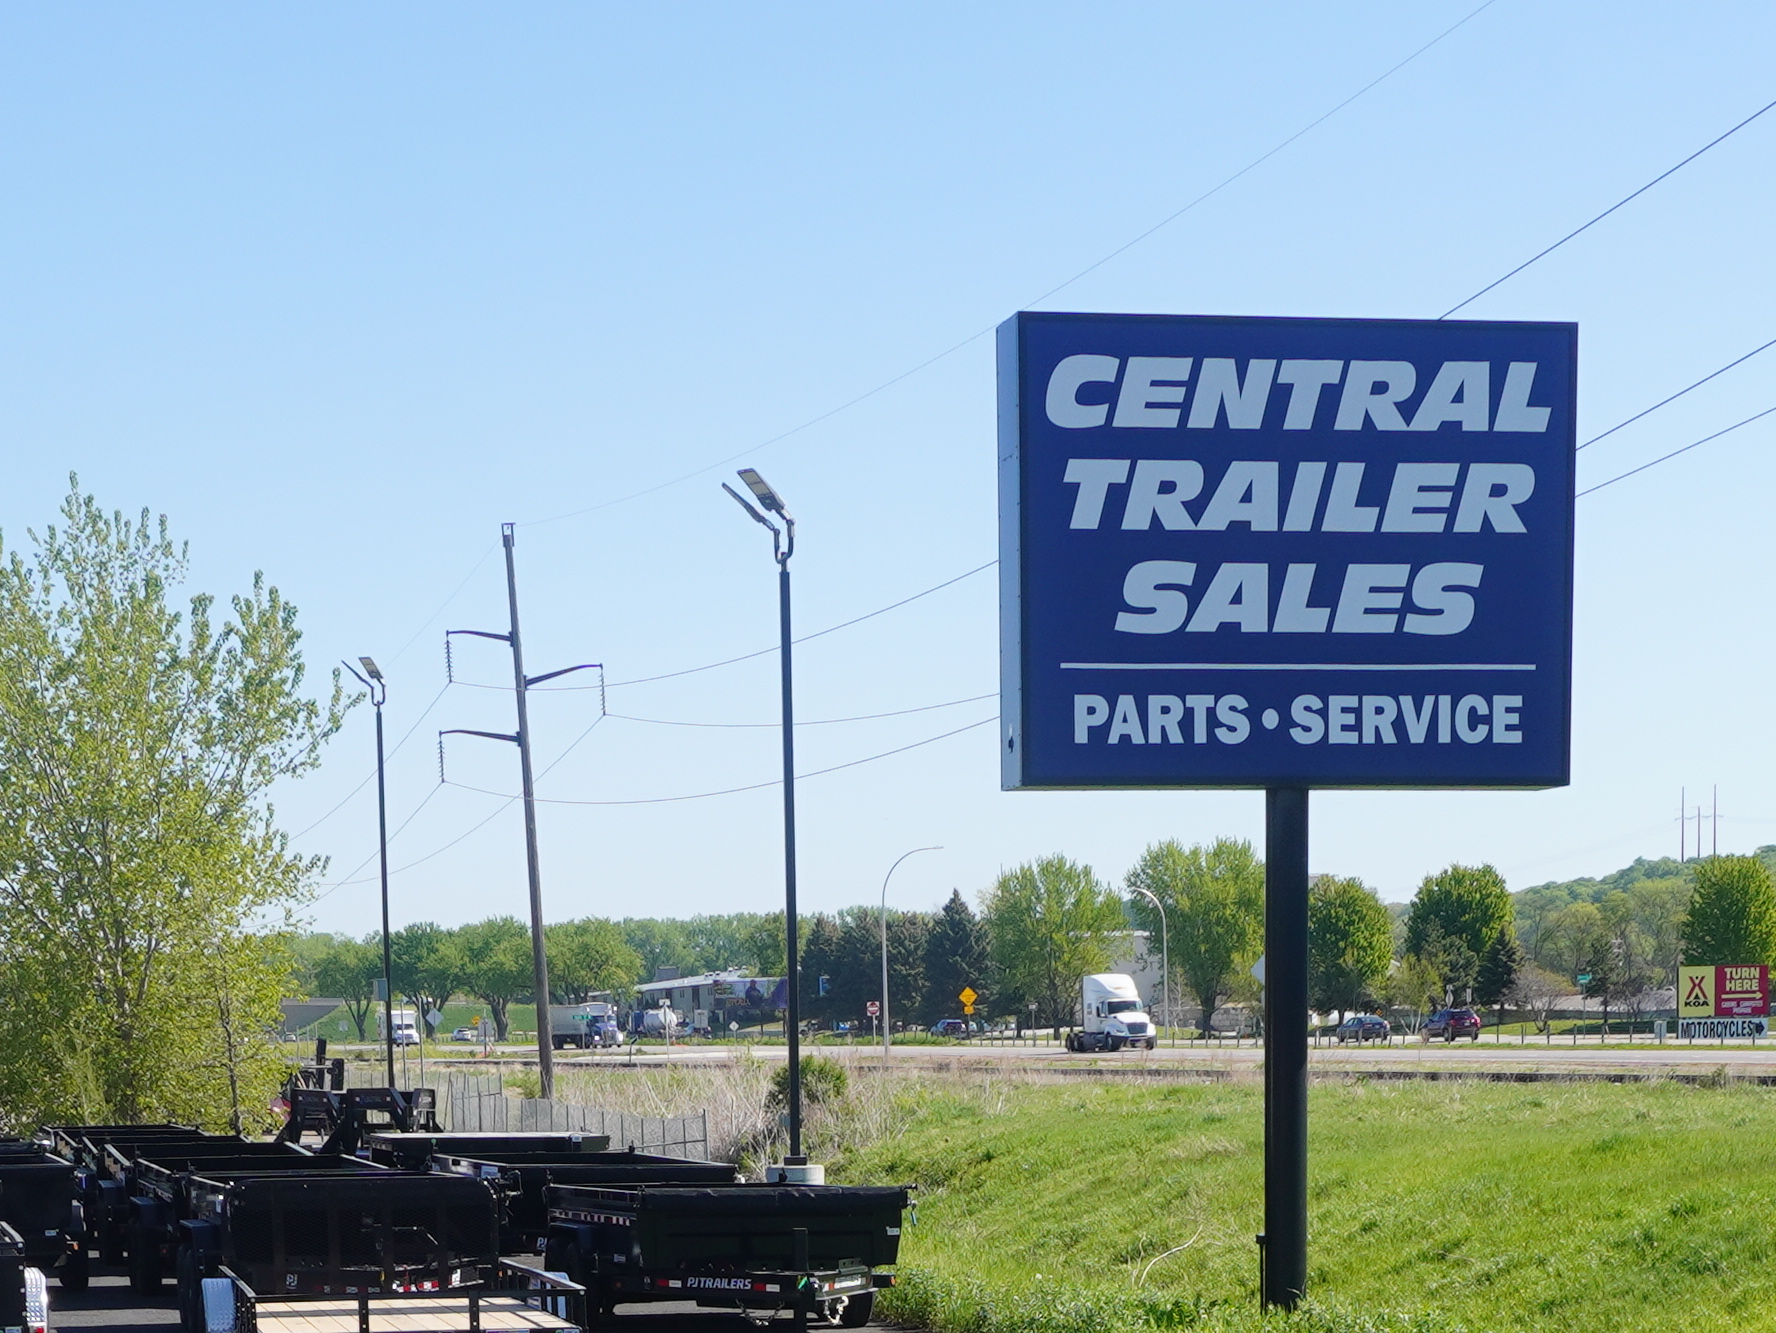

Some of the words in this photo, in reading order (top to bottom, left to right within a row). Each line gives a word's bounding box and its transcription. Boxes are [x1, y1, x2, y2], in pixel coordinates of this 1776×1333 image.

[1045, 353, 1553, 433] CENTRAL
[1062, 458, 1536, 533] TRAILER
[1113, 559, 1485, 636] SALES
[1073, 693, 1251, 745] PARTS
[1288, 693, 1524, 745] SERVICE
[1724, 966, 1761, 979] TURN
[1725, 979, 1760, 992] HERE
[1680, 1020, 1754, 1039] MOTORCYCLES
